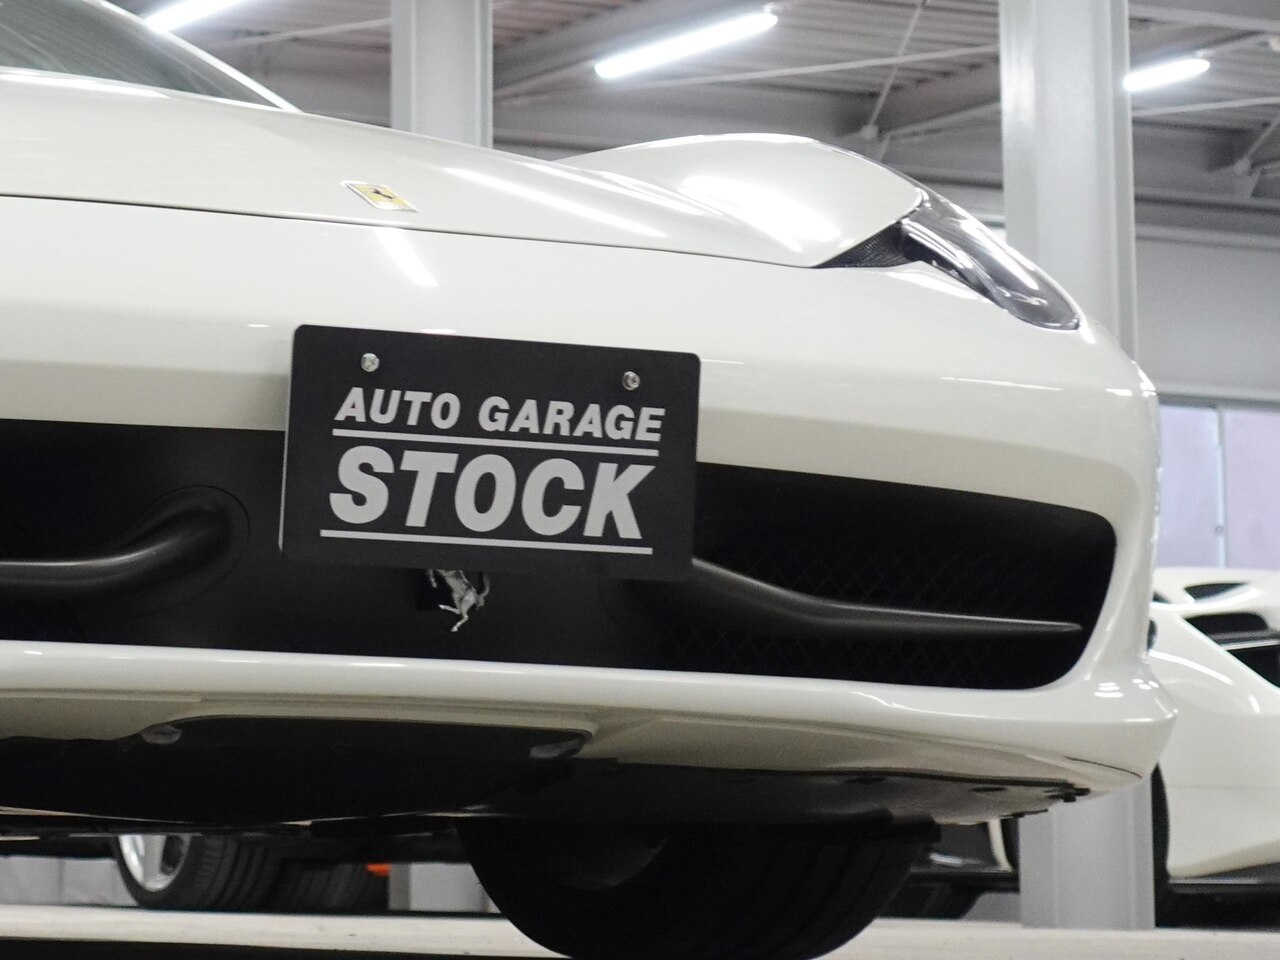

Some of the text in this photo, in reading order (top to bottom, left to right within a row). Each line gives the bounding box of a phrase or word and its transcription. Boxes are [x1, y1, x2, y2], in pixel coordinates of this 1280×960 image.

[334, 386, 666, 442] AUTO GARAGE
[329, 445, 656, 540] STOCK
